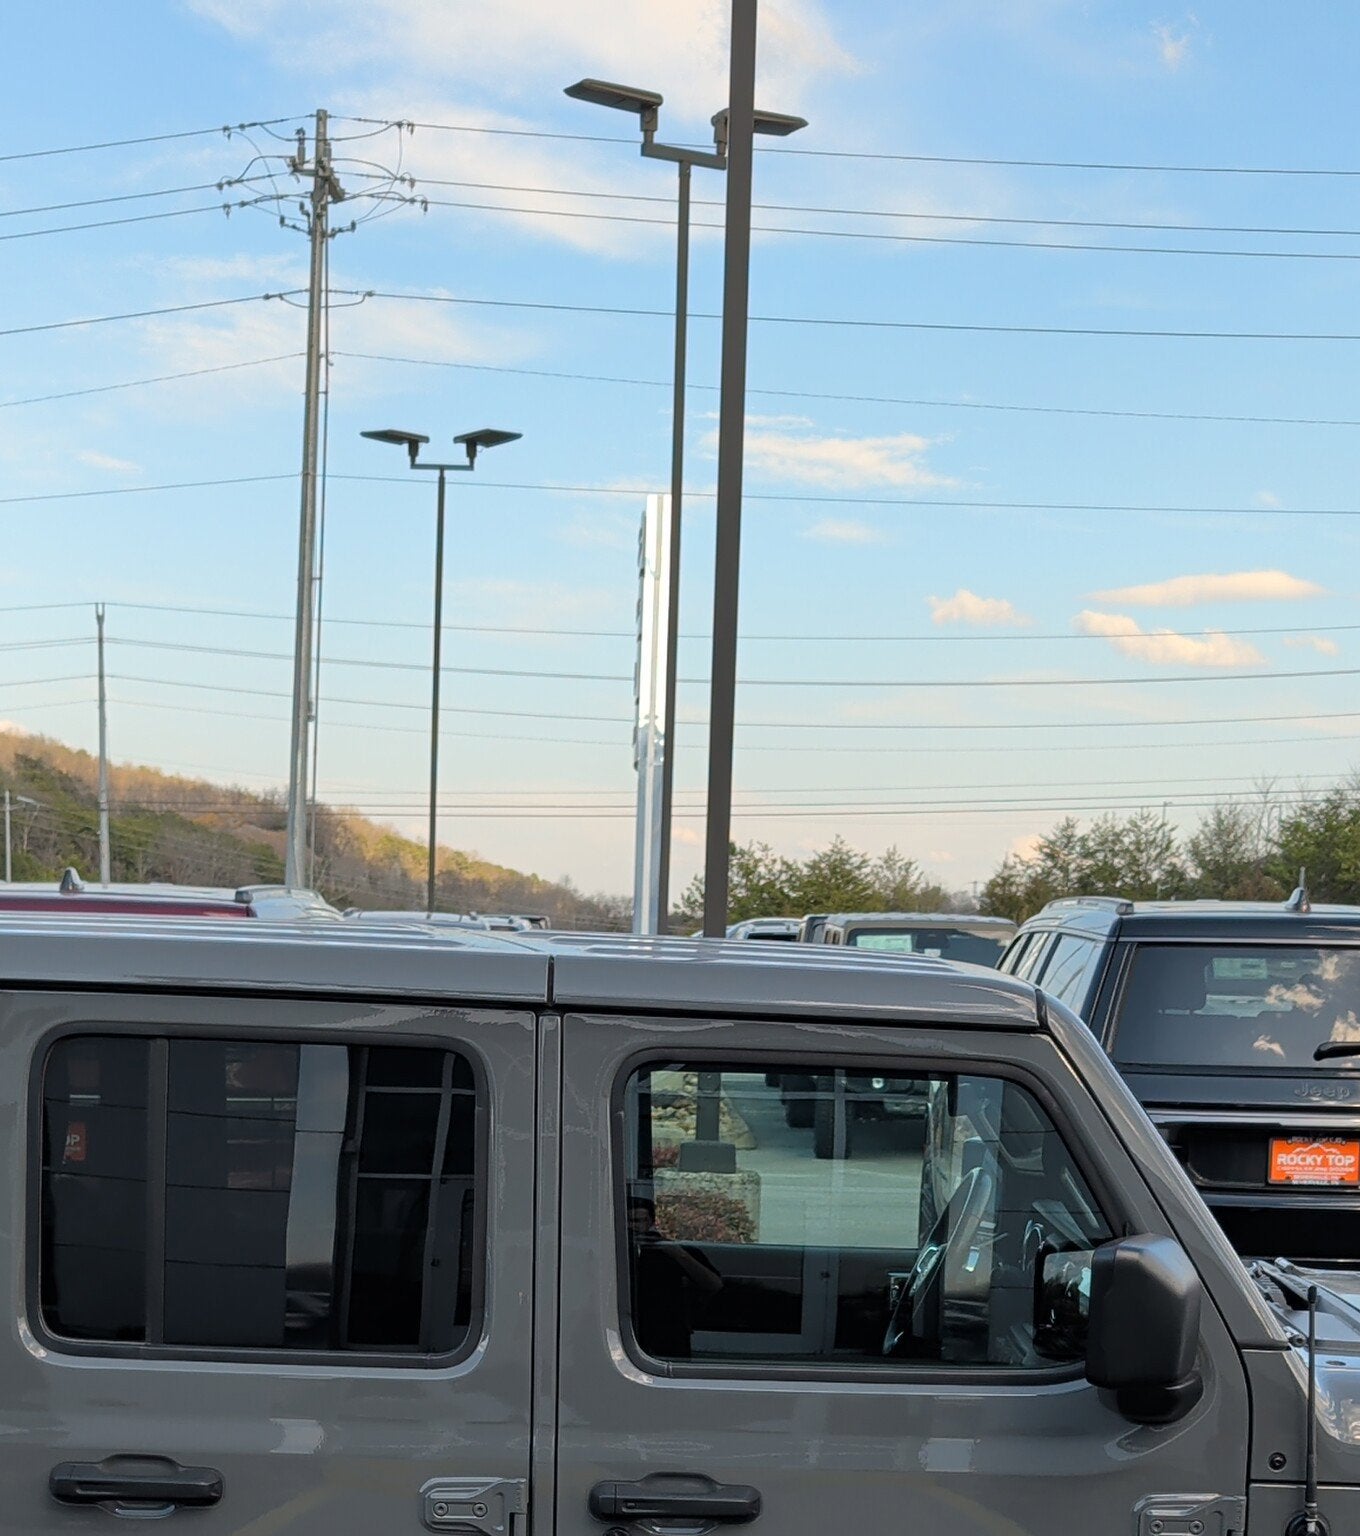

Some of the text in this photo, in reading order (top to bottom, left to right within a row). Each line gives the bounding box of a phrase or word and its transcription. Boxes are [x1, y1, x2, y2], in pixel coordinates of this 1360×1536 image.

[1294, 1081, 1352, 1100] Jeep
[1277, 1154, 1356, 1167] ROCKY TOP
